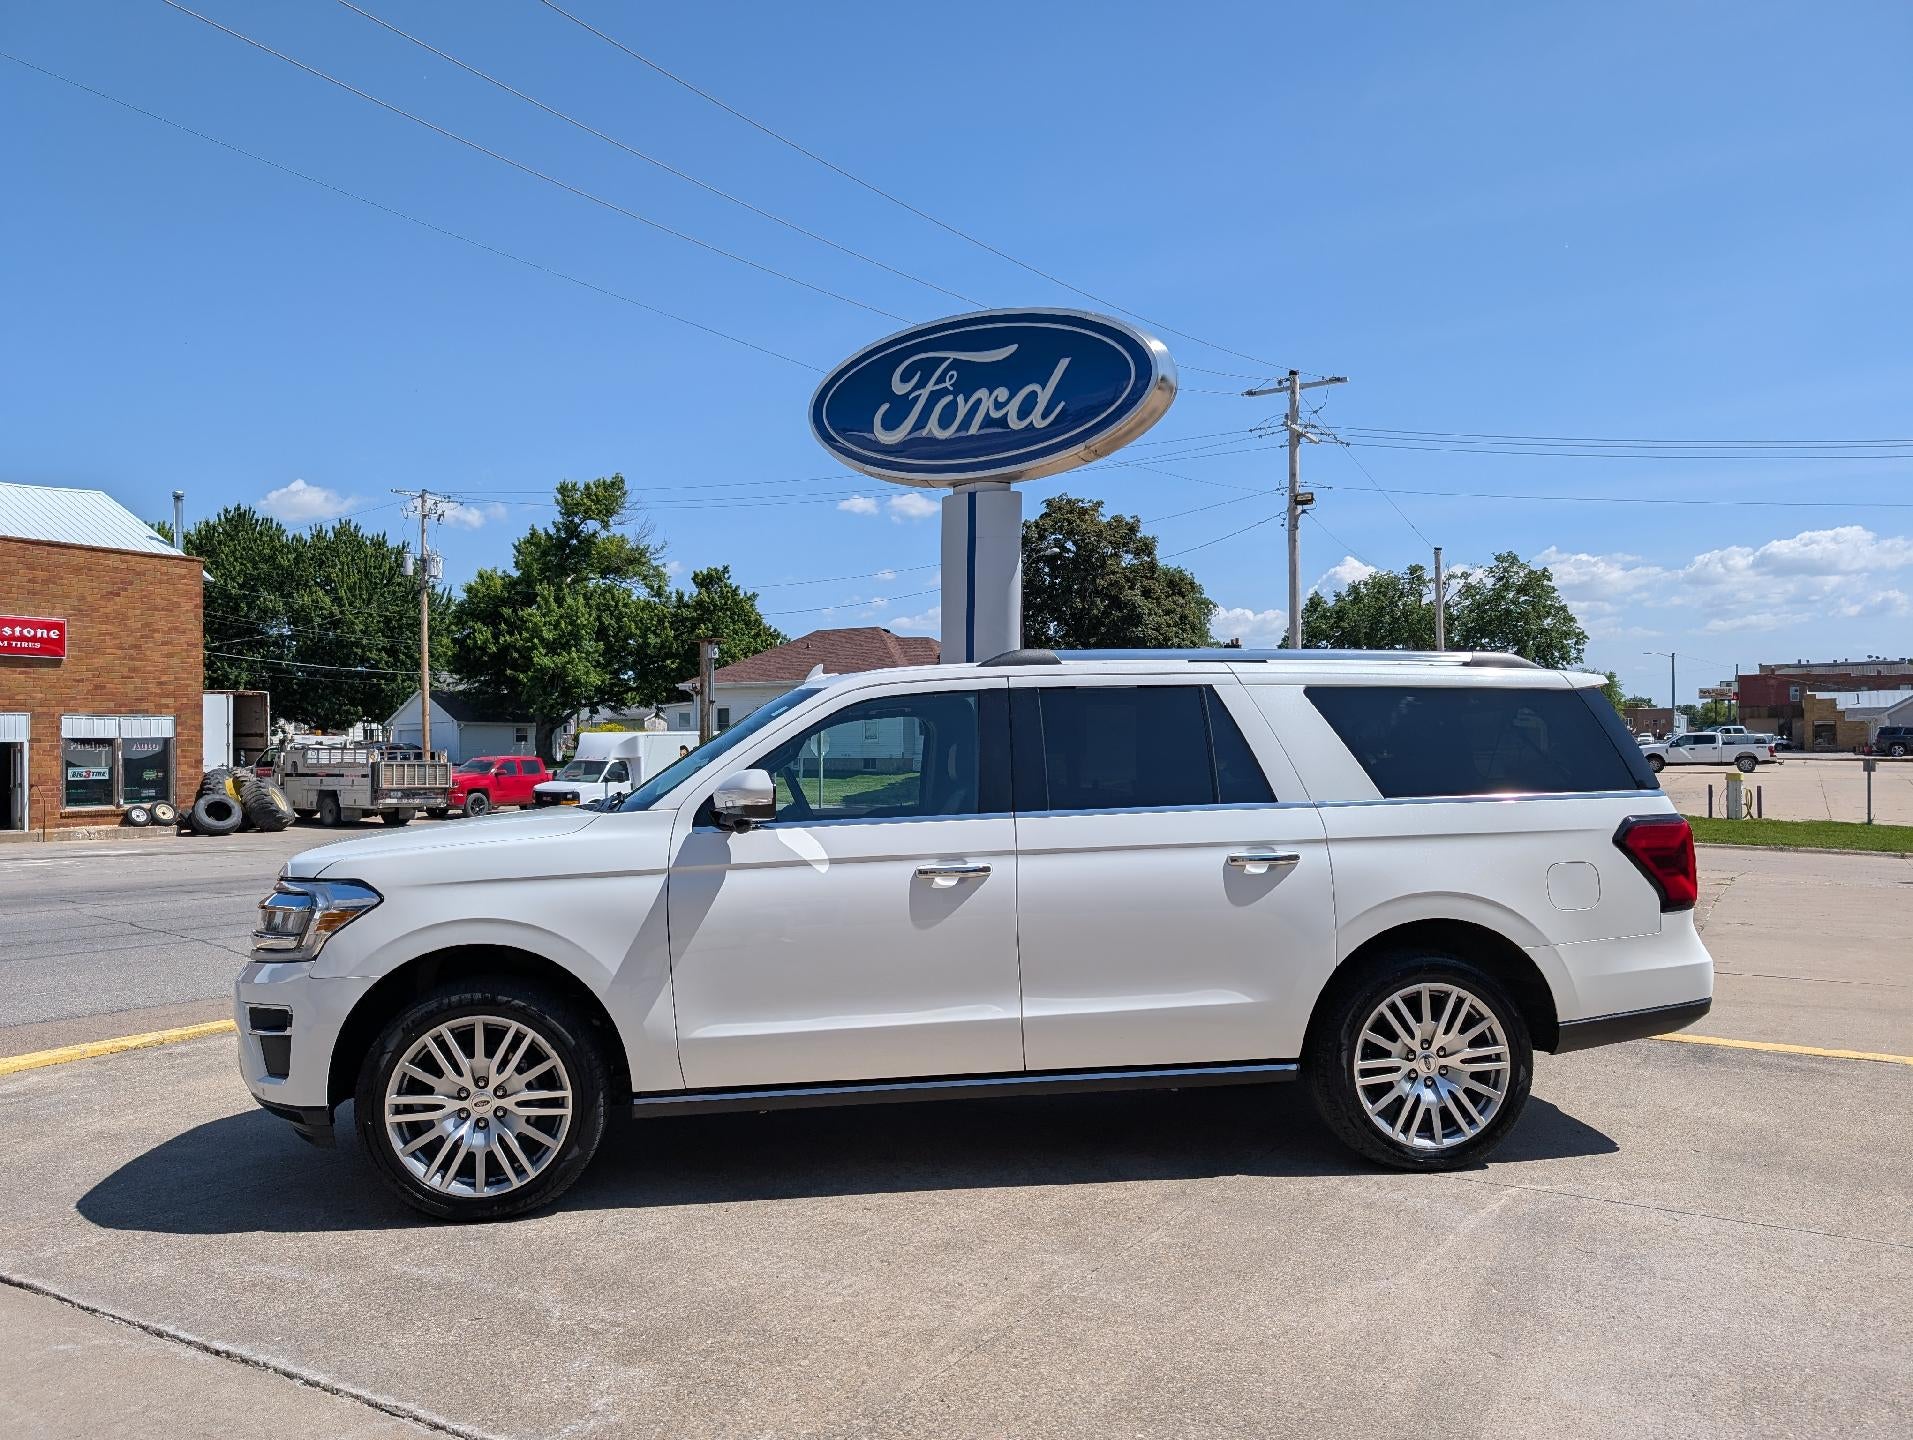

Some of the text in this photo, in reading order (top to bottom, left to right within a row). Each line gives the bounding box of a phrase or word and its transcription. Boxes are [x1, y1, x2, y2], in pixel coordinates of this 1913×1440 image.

[873, 344, 1071, 444] Ford
[2, 626, 60, 638] stone
[131, 741, 160, 751] Auto
